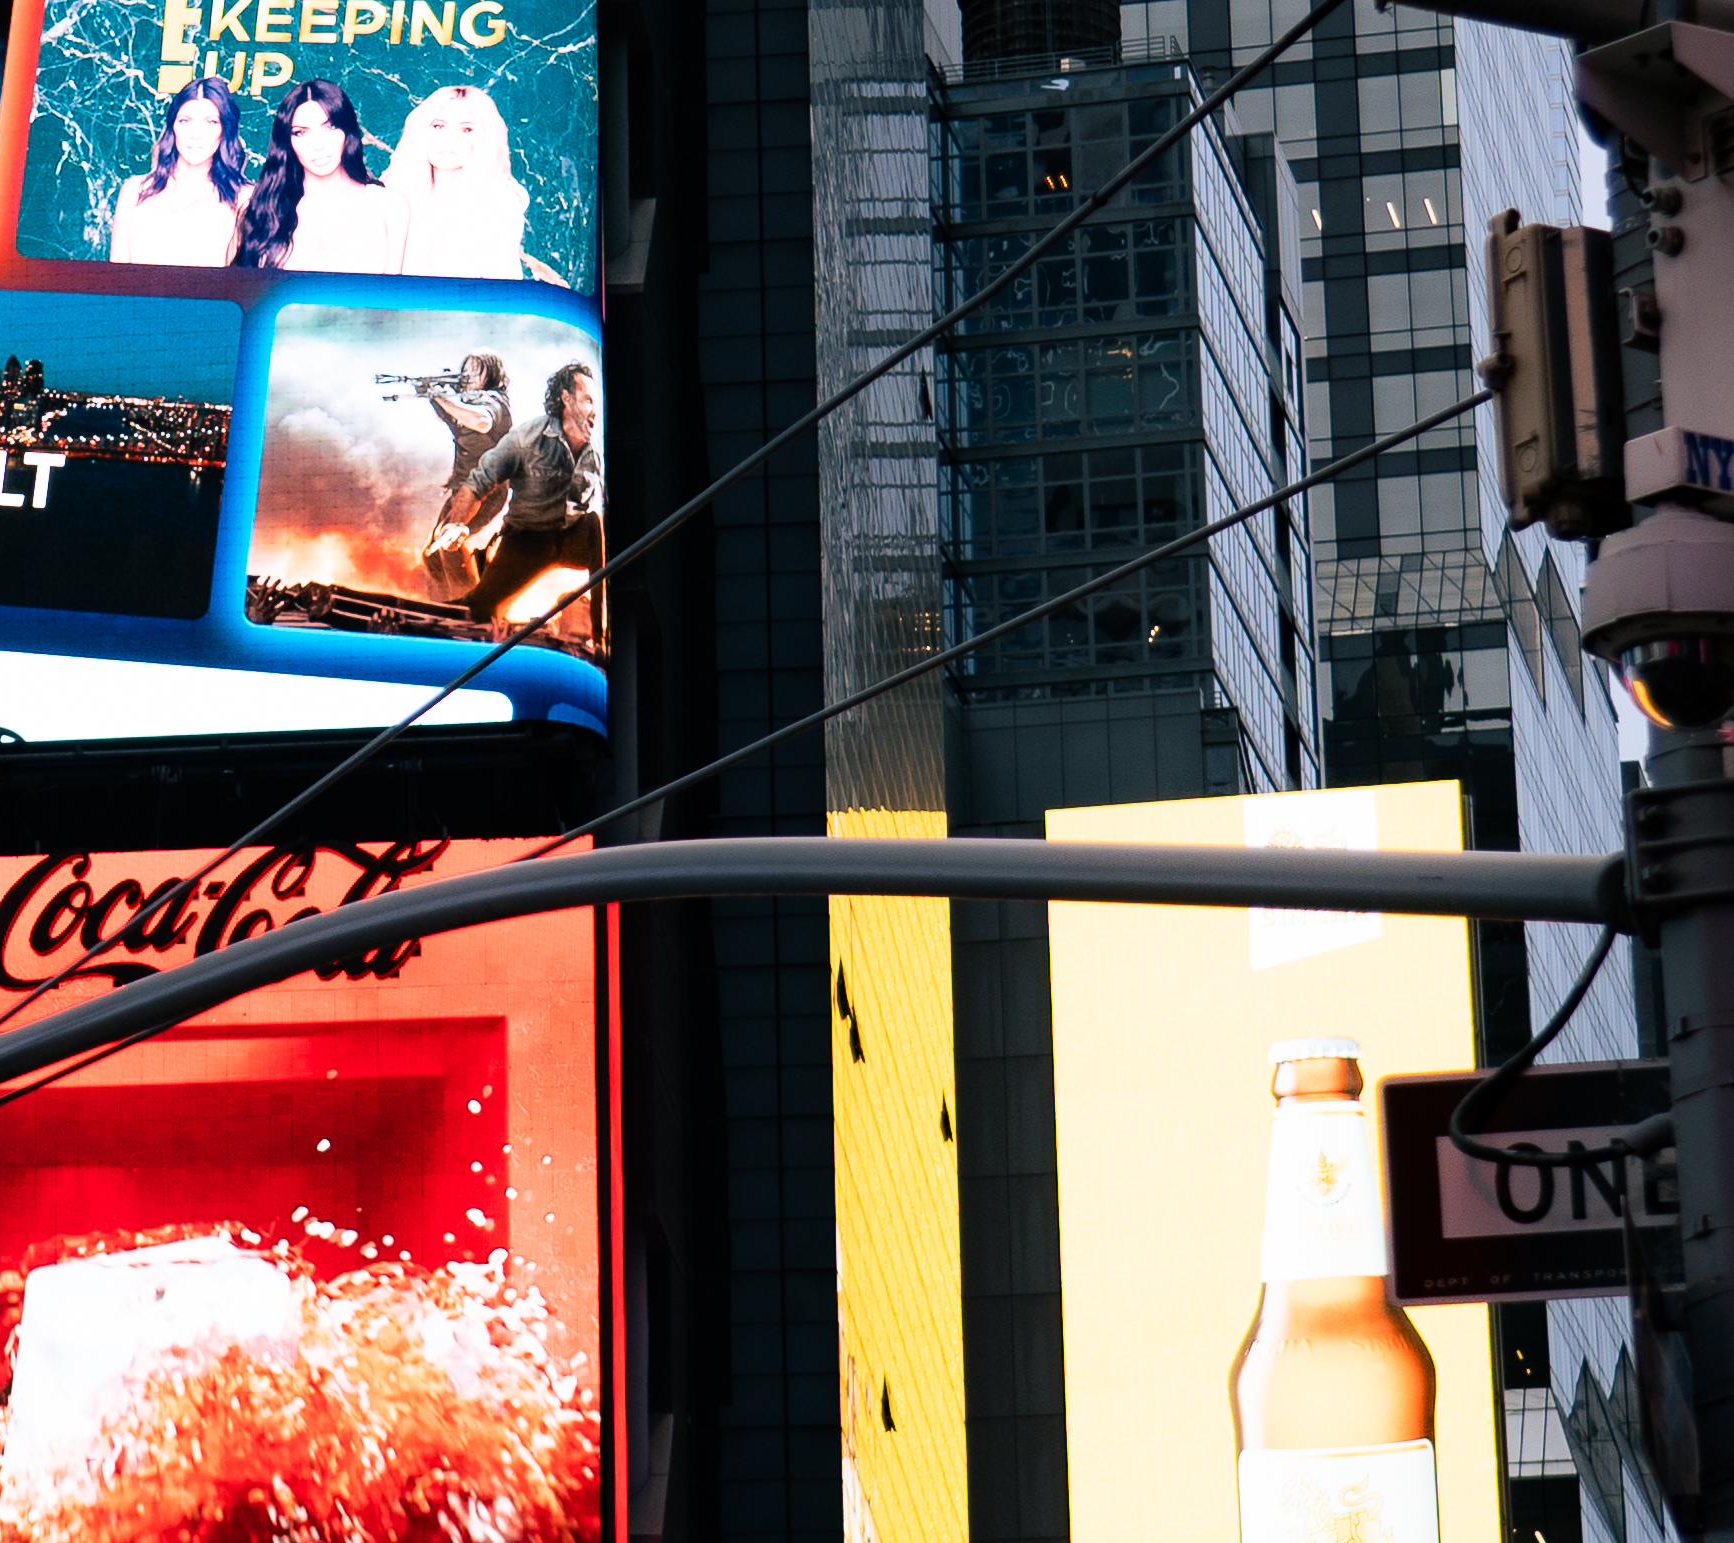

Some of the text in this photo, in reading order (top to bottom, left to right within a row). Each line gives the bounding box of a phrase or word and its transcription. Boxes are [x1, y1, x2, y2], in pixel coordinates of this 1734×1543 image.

[202, 50, 295, 97] UP
[1489, 1273, 1512, 1286] OF
[1532, 1267, 1629, 1283] TRANSPOR
